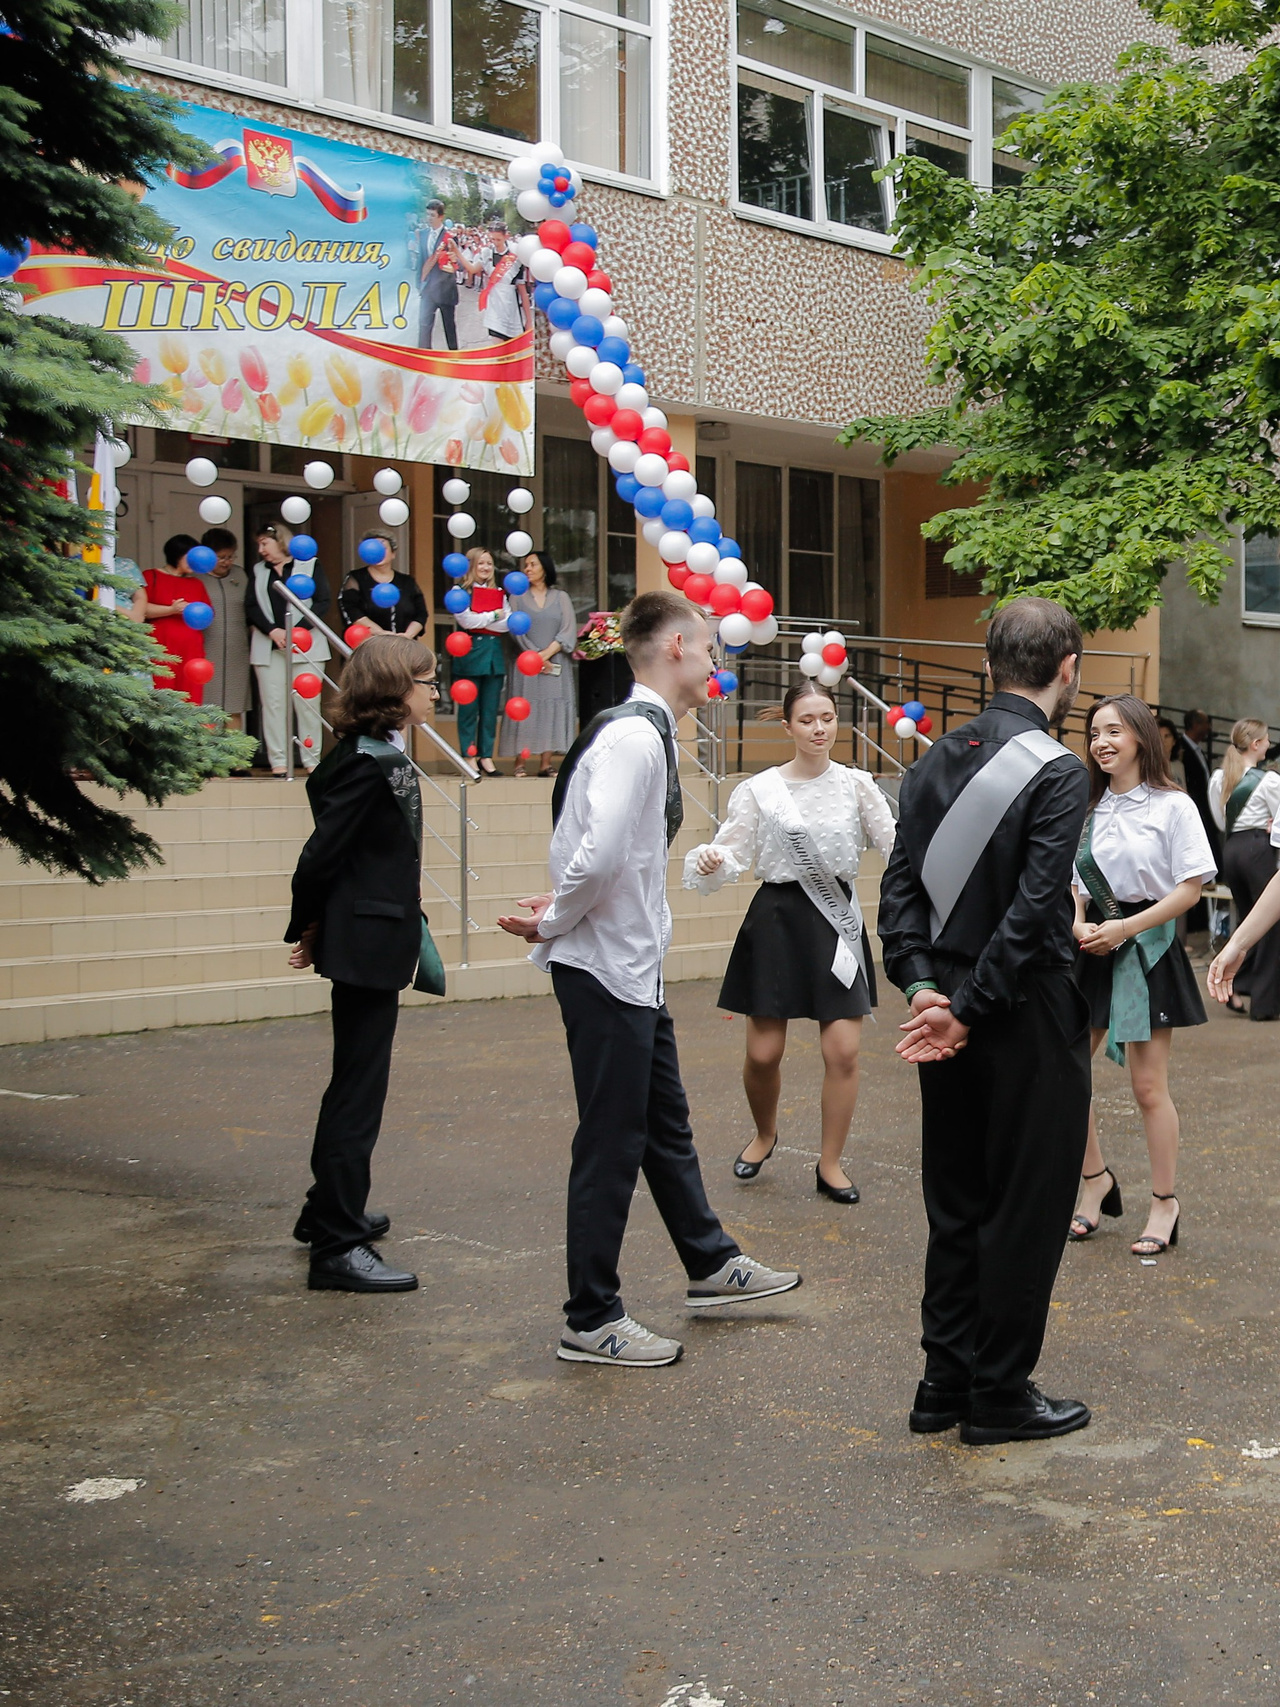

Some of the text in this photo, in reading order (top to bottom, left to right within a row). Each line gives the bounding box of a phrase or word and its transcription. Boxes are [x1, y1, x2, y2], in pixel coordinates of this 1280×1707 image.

[211, 229, 391, 270] свидания,
[101, 280, 411, 332] ШКОЛА!
[782, 818, 838, 908] Выпускница
